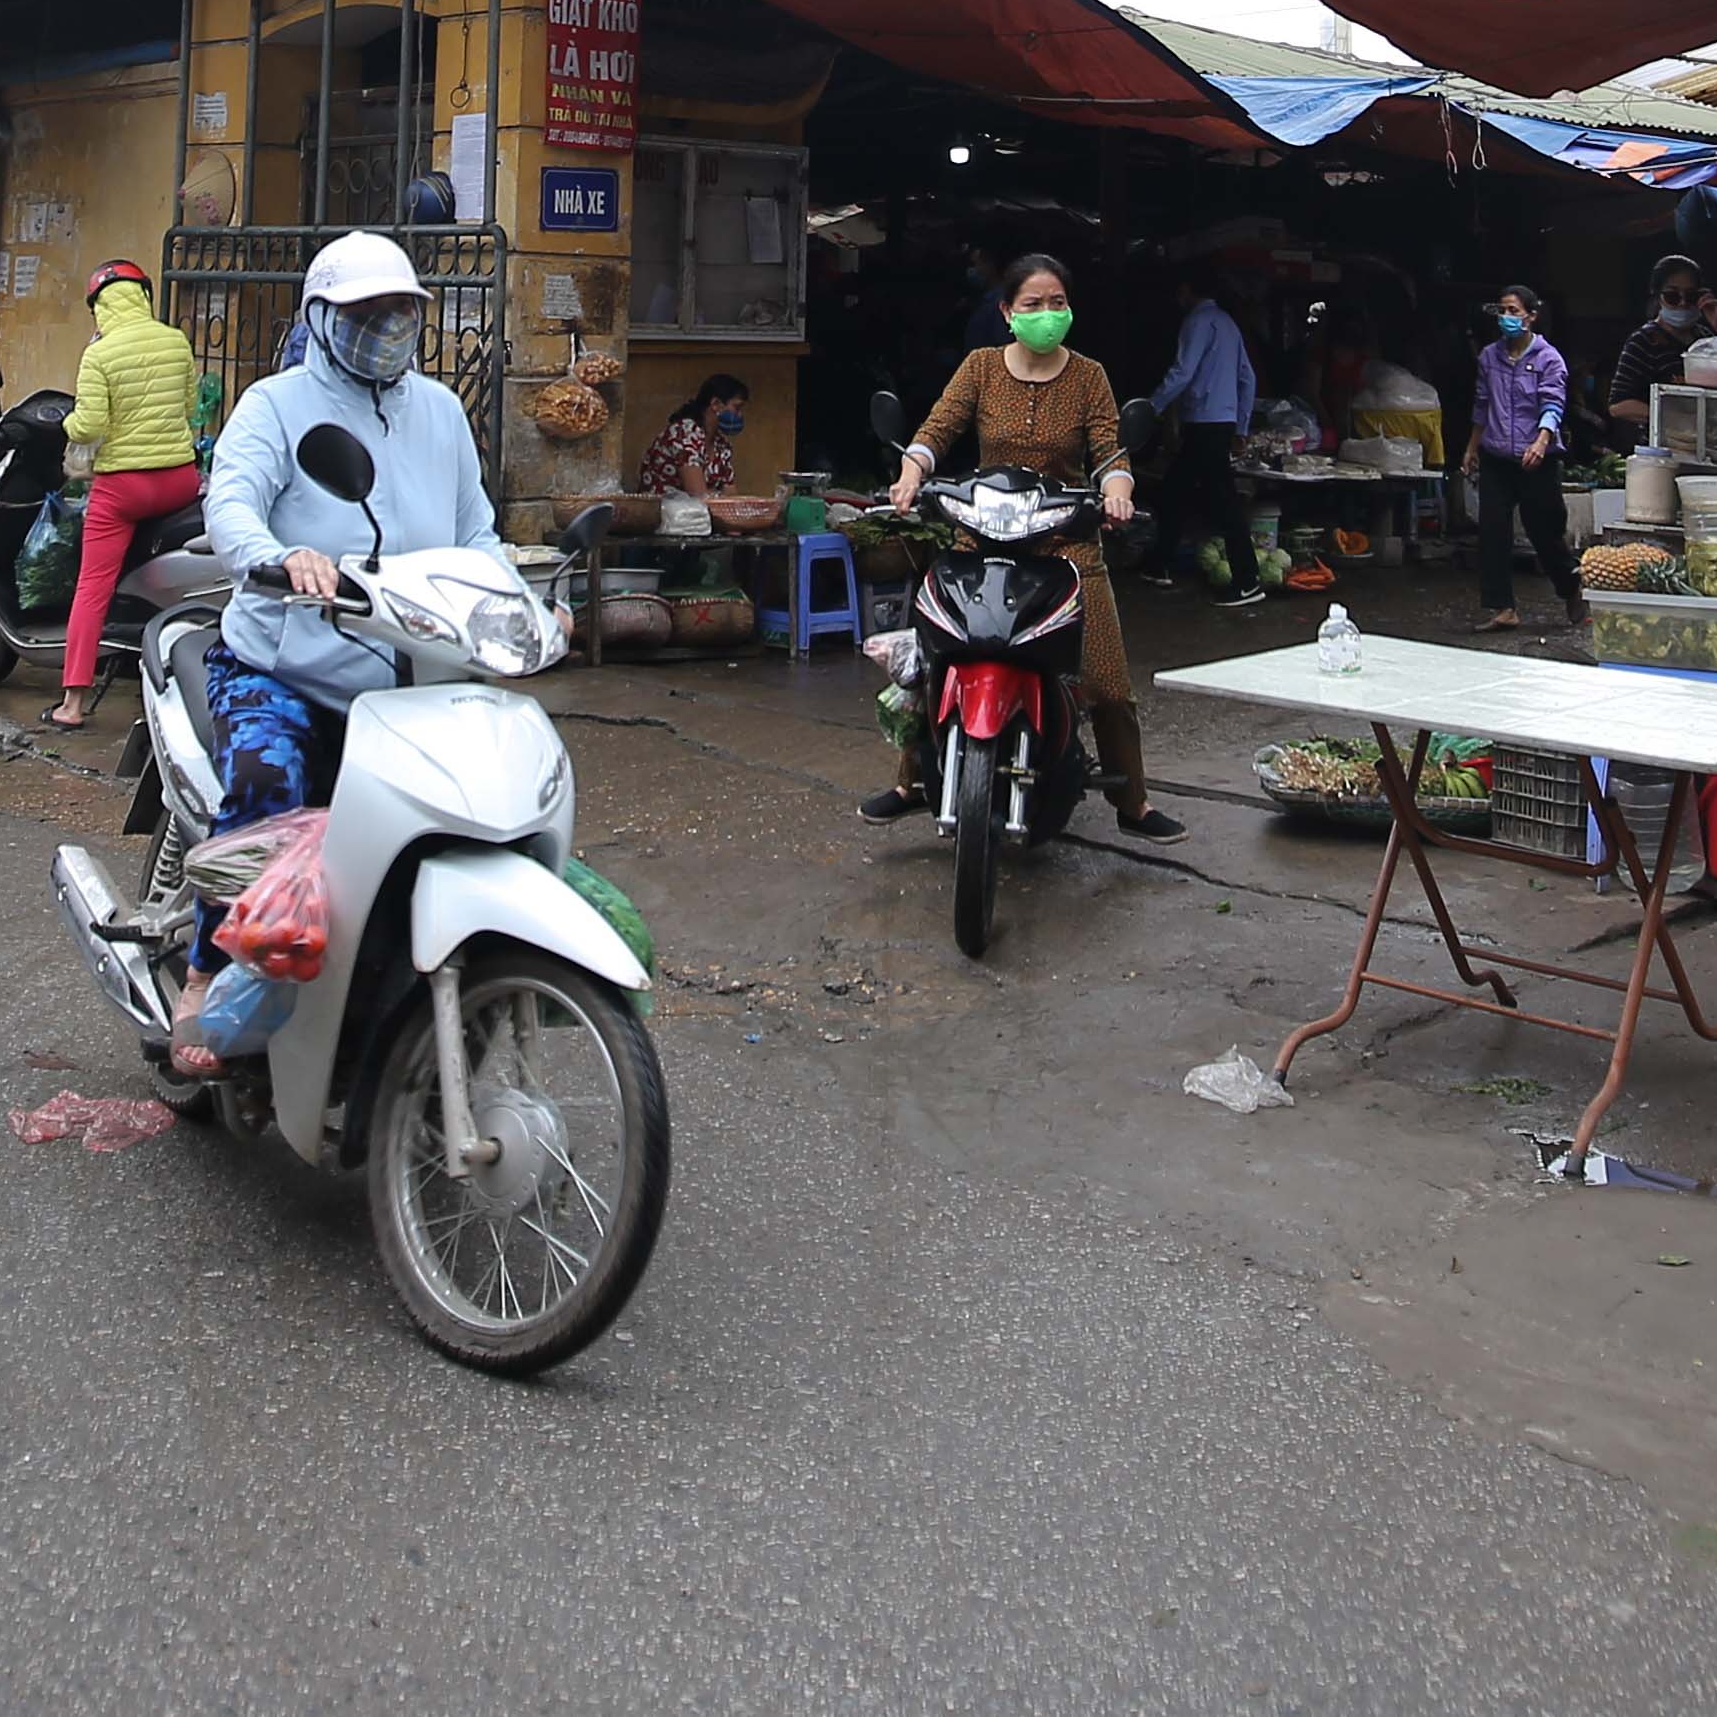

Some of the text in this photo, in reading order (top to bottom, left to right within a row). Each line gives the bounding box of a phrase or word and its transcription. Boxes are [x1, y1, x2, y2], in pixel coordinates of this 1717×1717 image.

[549, 40, 635, 83] LÀ HƠI
[554, 185, 605, 215] NHÀ XE
